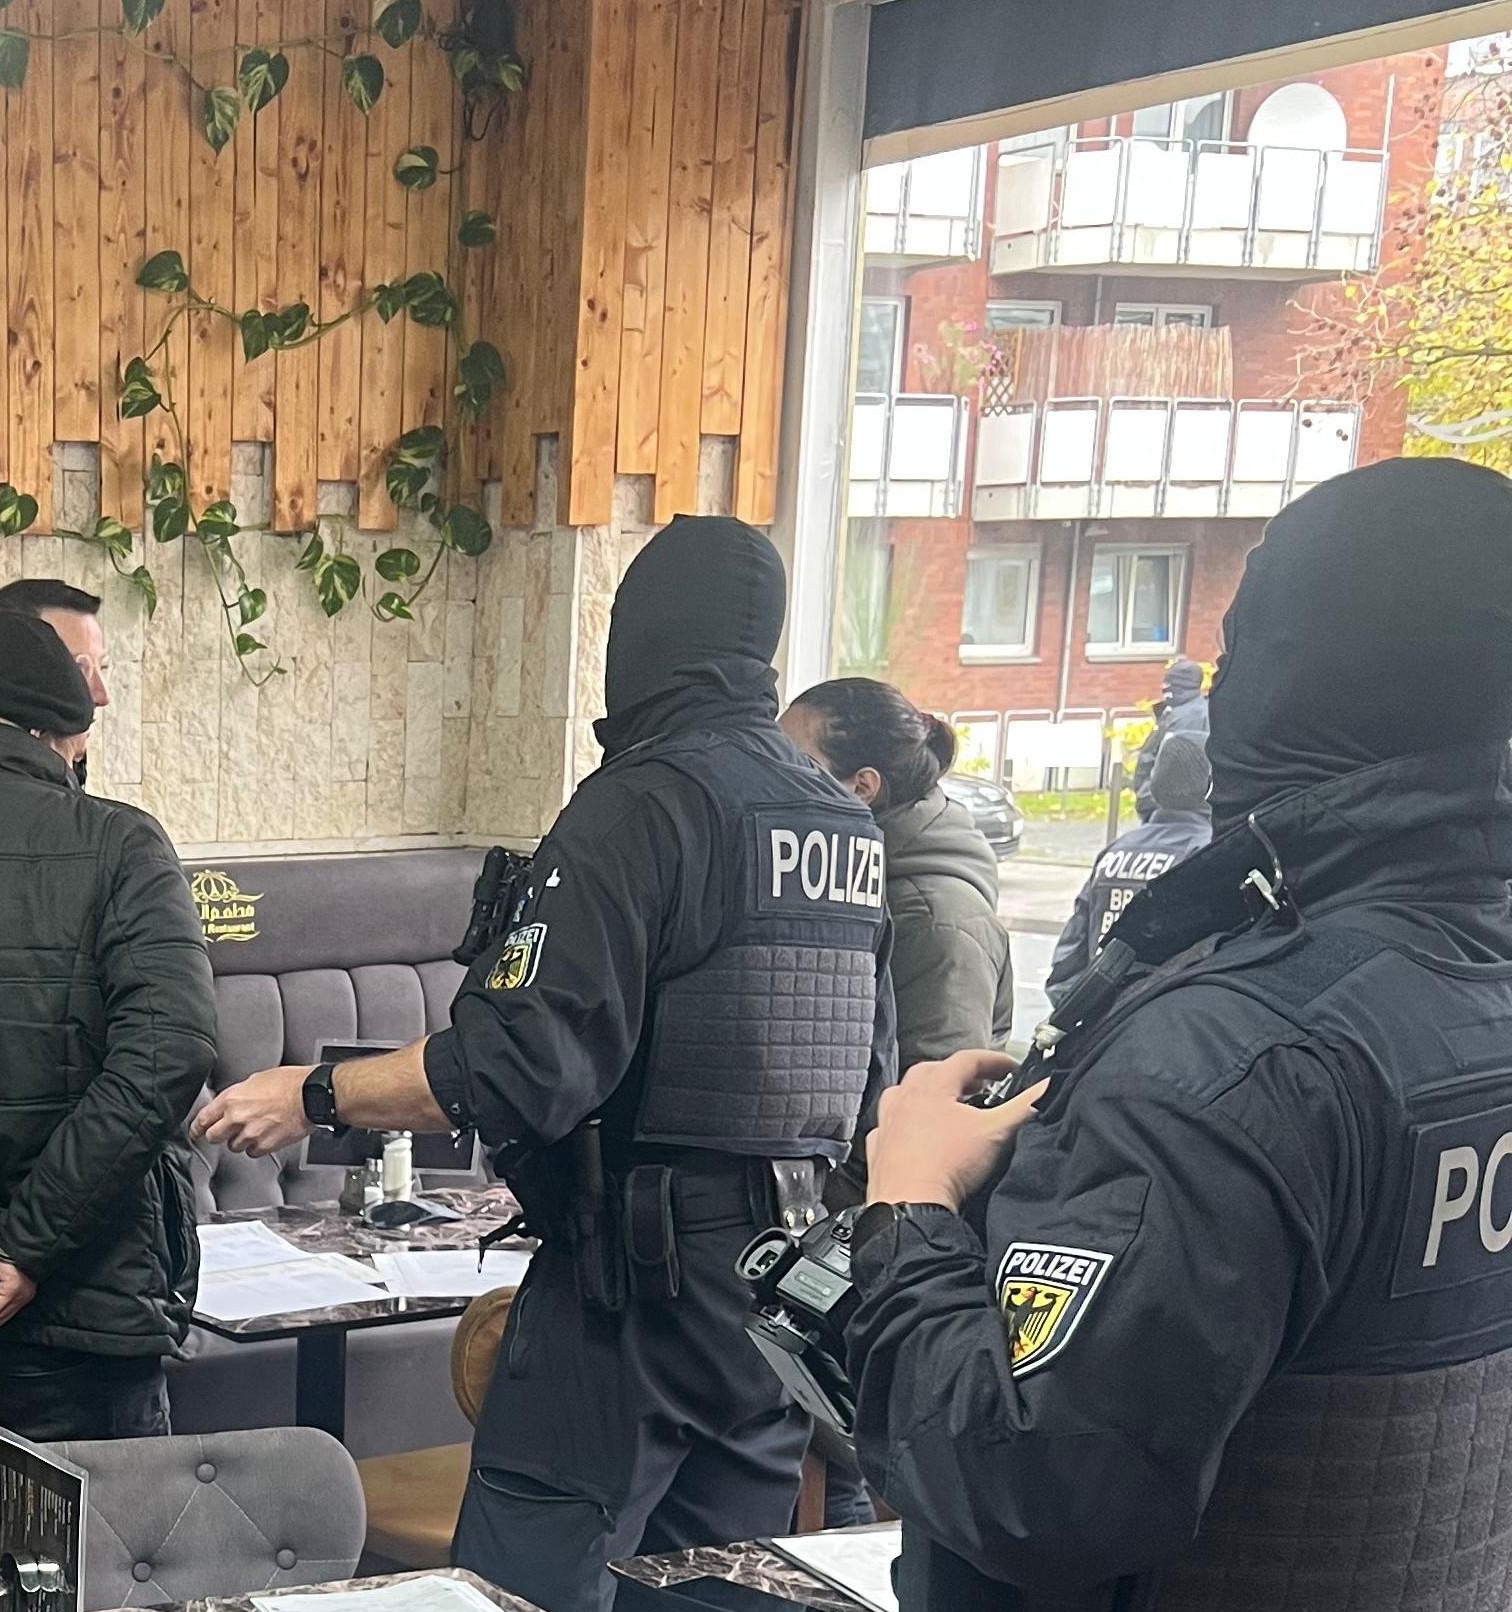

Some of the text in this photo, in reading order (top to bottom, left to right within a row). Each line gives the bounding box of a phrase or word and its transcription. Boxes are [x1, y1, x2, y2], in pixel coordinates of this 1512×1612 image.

[771, 829, 884, 908] POLIZEI
[1095, 851, 1176, 880] POLIZEI
[1004, 1251, 1098, 1286] POLIZEI
